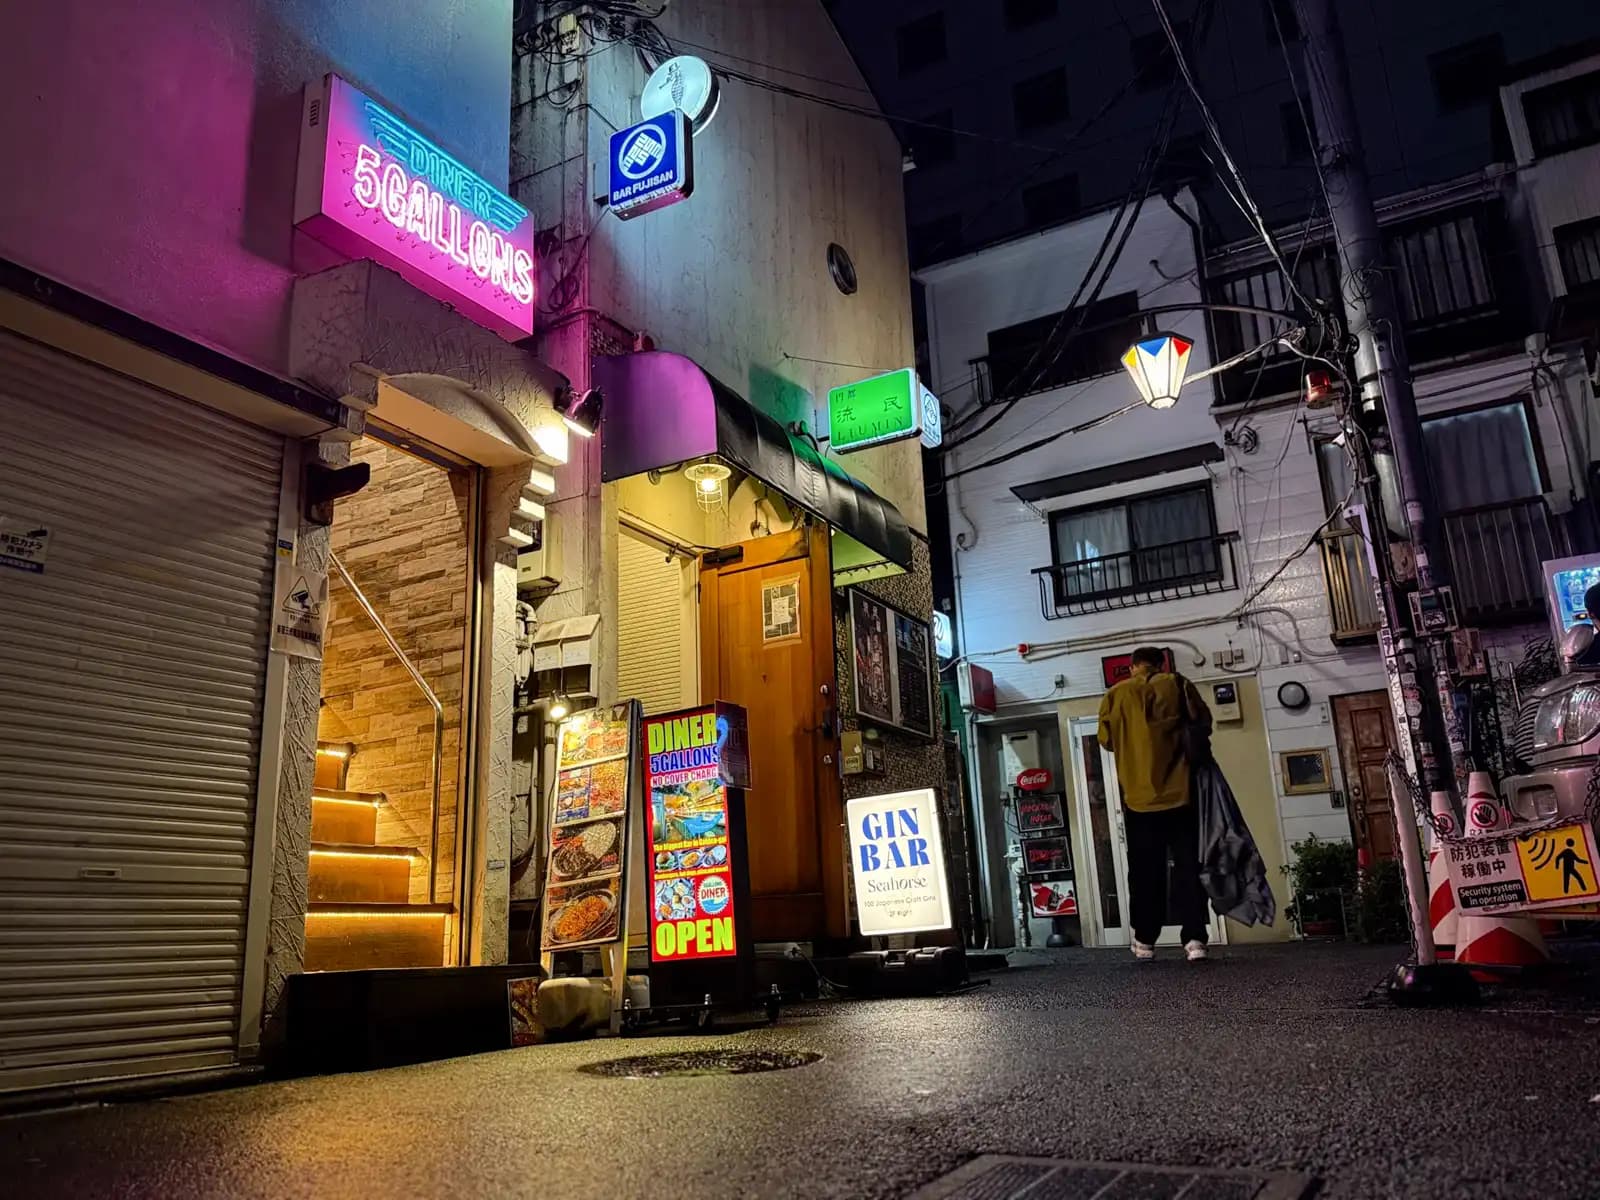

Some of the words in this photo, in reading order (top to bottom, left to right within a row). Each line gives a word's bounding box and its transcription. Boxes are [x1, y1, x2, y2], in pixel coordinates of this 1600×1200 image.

[410, 139, 491, 220] DINER
[613, 186, 632, 201] BAR
[633, 169, 674, 194] FUJISAN
[354, 143, 534, 304] 5GALLONS
[648, 713, 717, 754] DINER
[650, 746, 719, 773] 5GALLONS
[652, 776, 663, 787] NO
[664, 772, 689, 785] COVER
[691, 767, 717, 781] CHARG
[862, 808, 919, 840] GIN
[859, 838, 931, 872] BAR
[1450, 839, 1511, 862] 防犯装置
[1460, 859, 1506, 878] 稼働中
[701, 887, 726, 900] DINER
[868, 876, 928, 893] Seahorse
[1460, 886, 1491, 898] Security
[1493, 882, 1521, 894] system
[1470, 898, 1477, 906] in
[656, 917, 734, 957] OPEN
